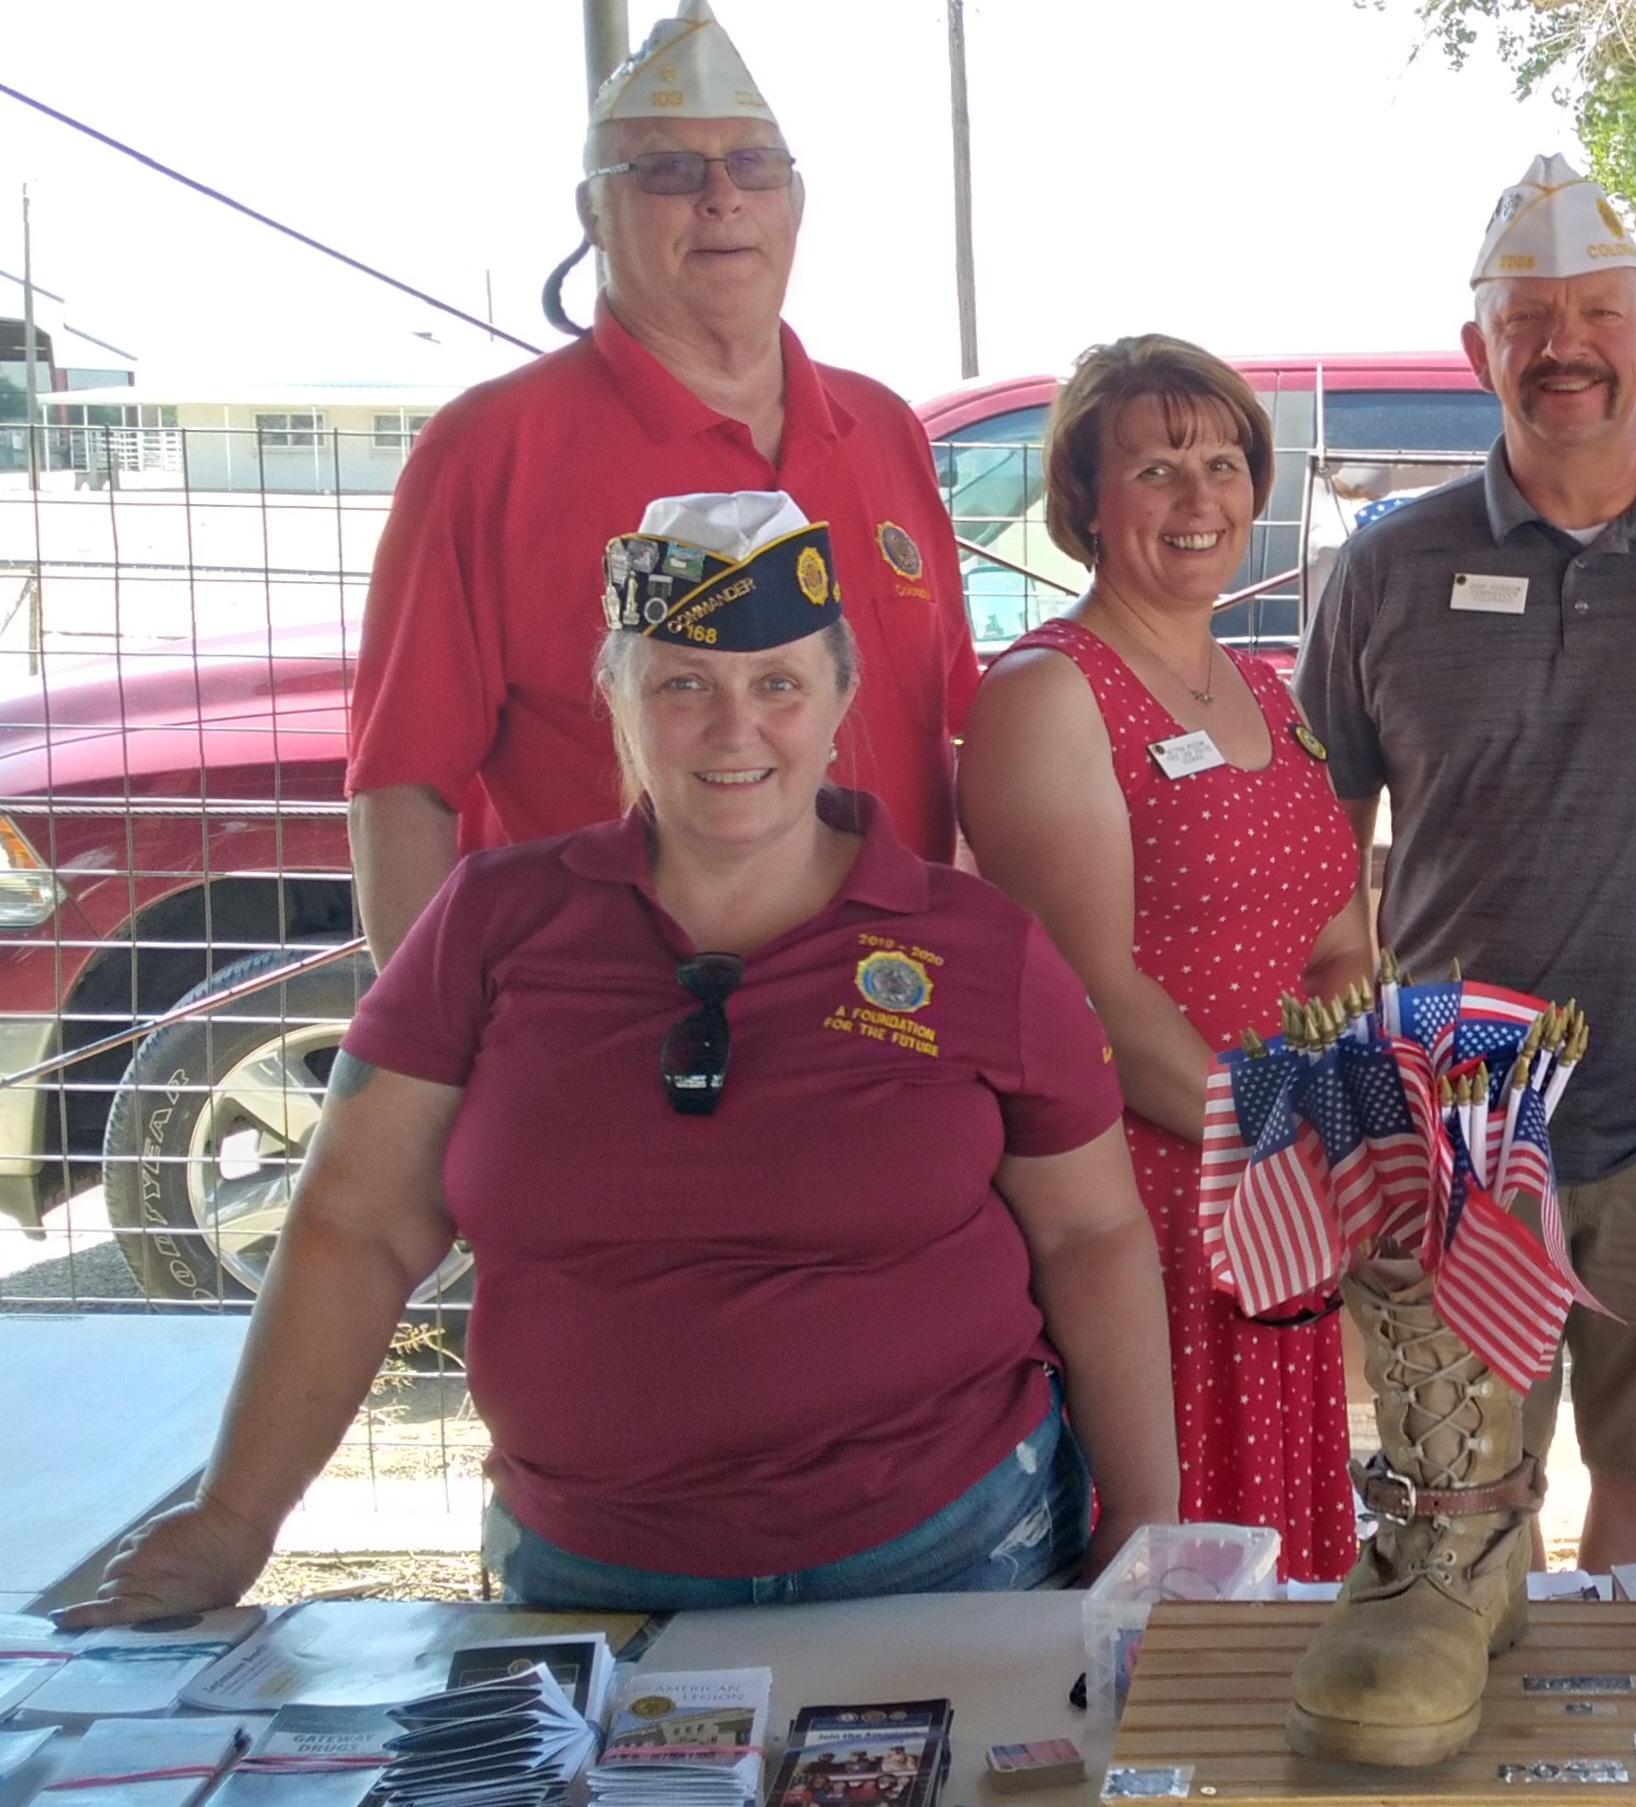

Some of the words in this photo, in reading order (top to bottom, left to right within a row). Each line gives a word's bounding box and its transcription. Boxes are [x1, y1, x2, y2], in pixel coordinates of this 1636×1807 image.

[667, 578, 757, 634] COMMANDER
[686, 625, 718, 645] 168
[910, 945, 947, 969] 2020
[835, 1006, 847, 1018] A
[852, 1007, 937, 1043] FOUNDATION
[823, 1016, 853, 1033] FOR
[860, 1023, 887, 1042] THE
[891, 1031, 941, 1059] FUTURE
[655, 1683, 741, 1693] AMERICAN
[682, 1692, 746, 1702] LEGION
[293, 1733, 376, 1744] GATEWAY
[818, 1730, 840, 1741] Join
[843, 1730, 862, 1741] the
[297, 1743, 360, 1754] DRUGS
